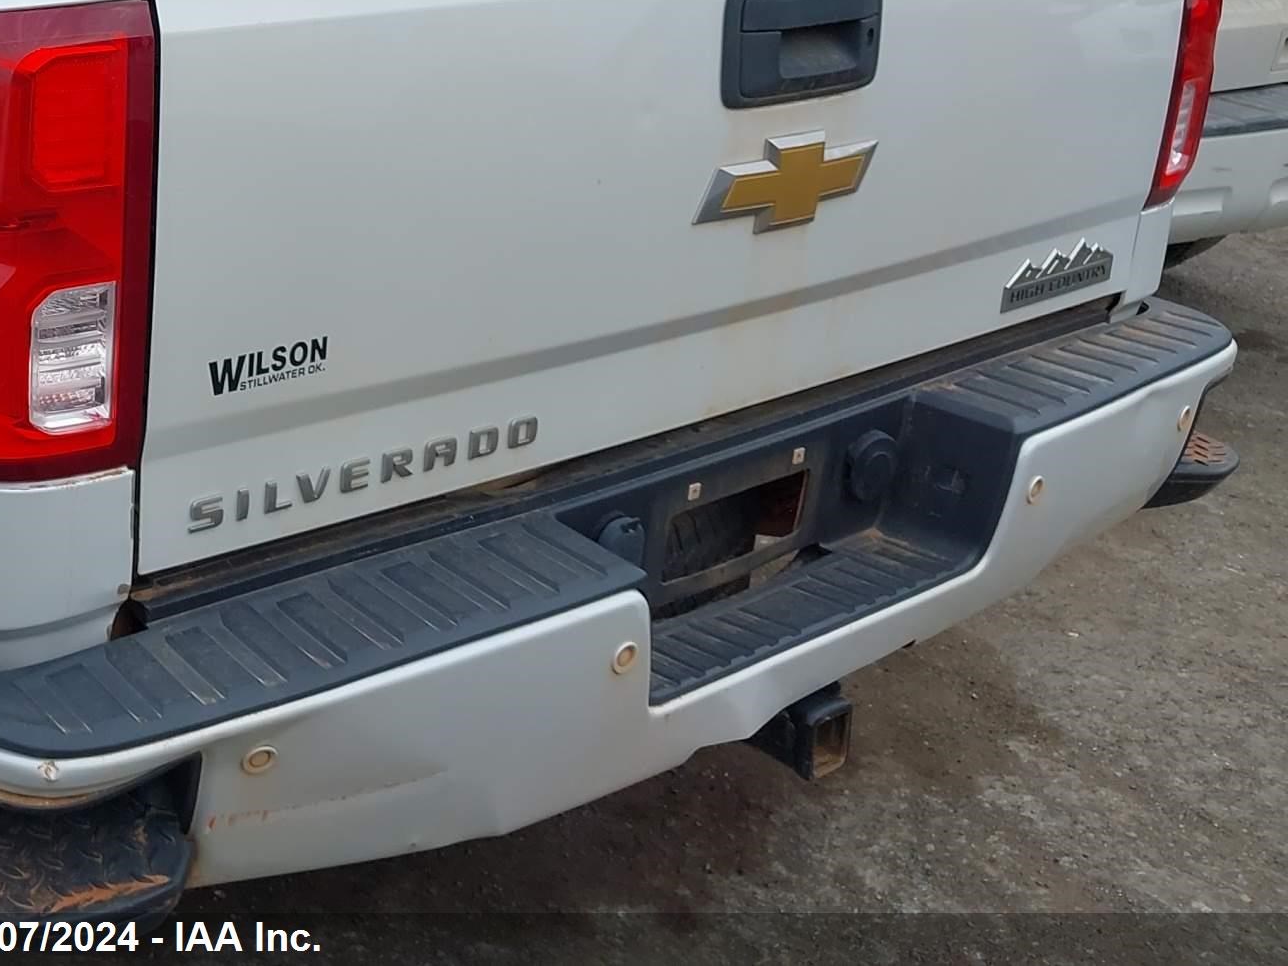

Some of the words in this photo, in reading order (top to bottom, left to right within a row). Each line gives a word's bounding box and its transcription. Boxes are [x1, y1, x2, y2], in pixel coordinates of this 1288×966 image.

[1009, 282, 1045, 304] HIGH
[1047, 264, 1107, 293] COUNTRY
[208, 336, 329, 396] WILSON
[239, 368, 306, 391] STILLWATER
[188, 415, 539, 534] SILVERADO
